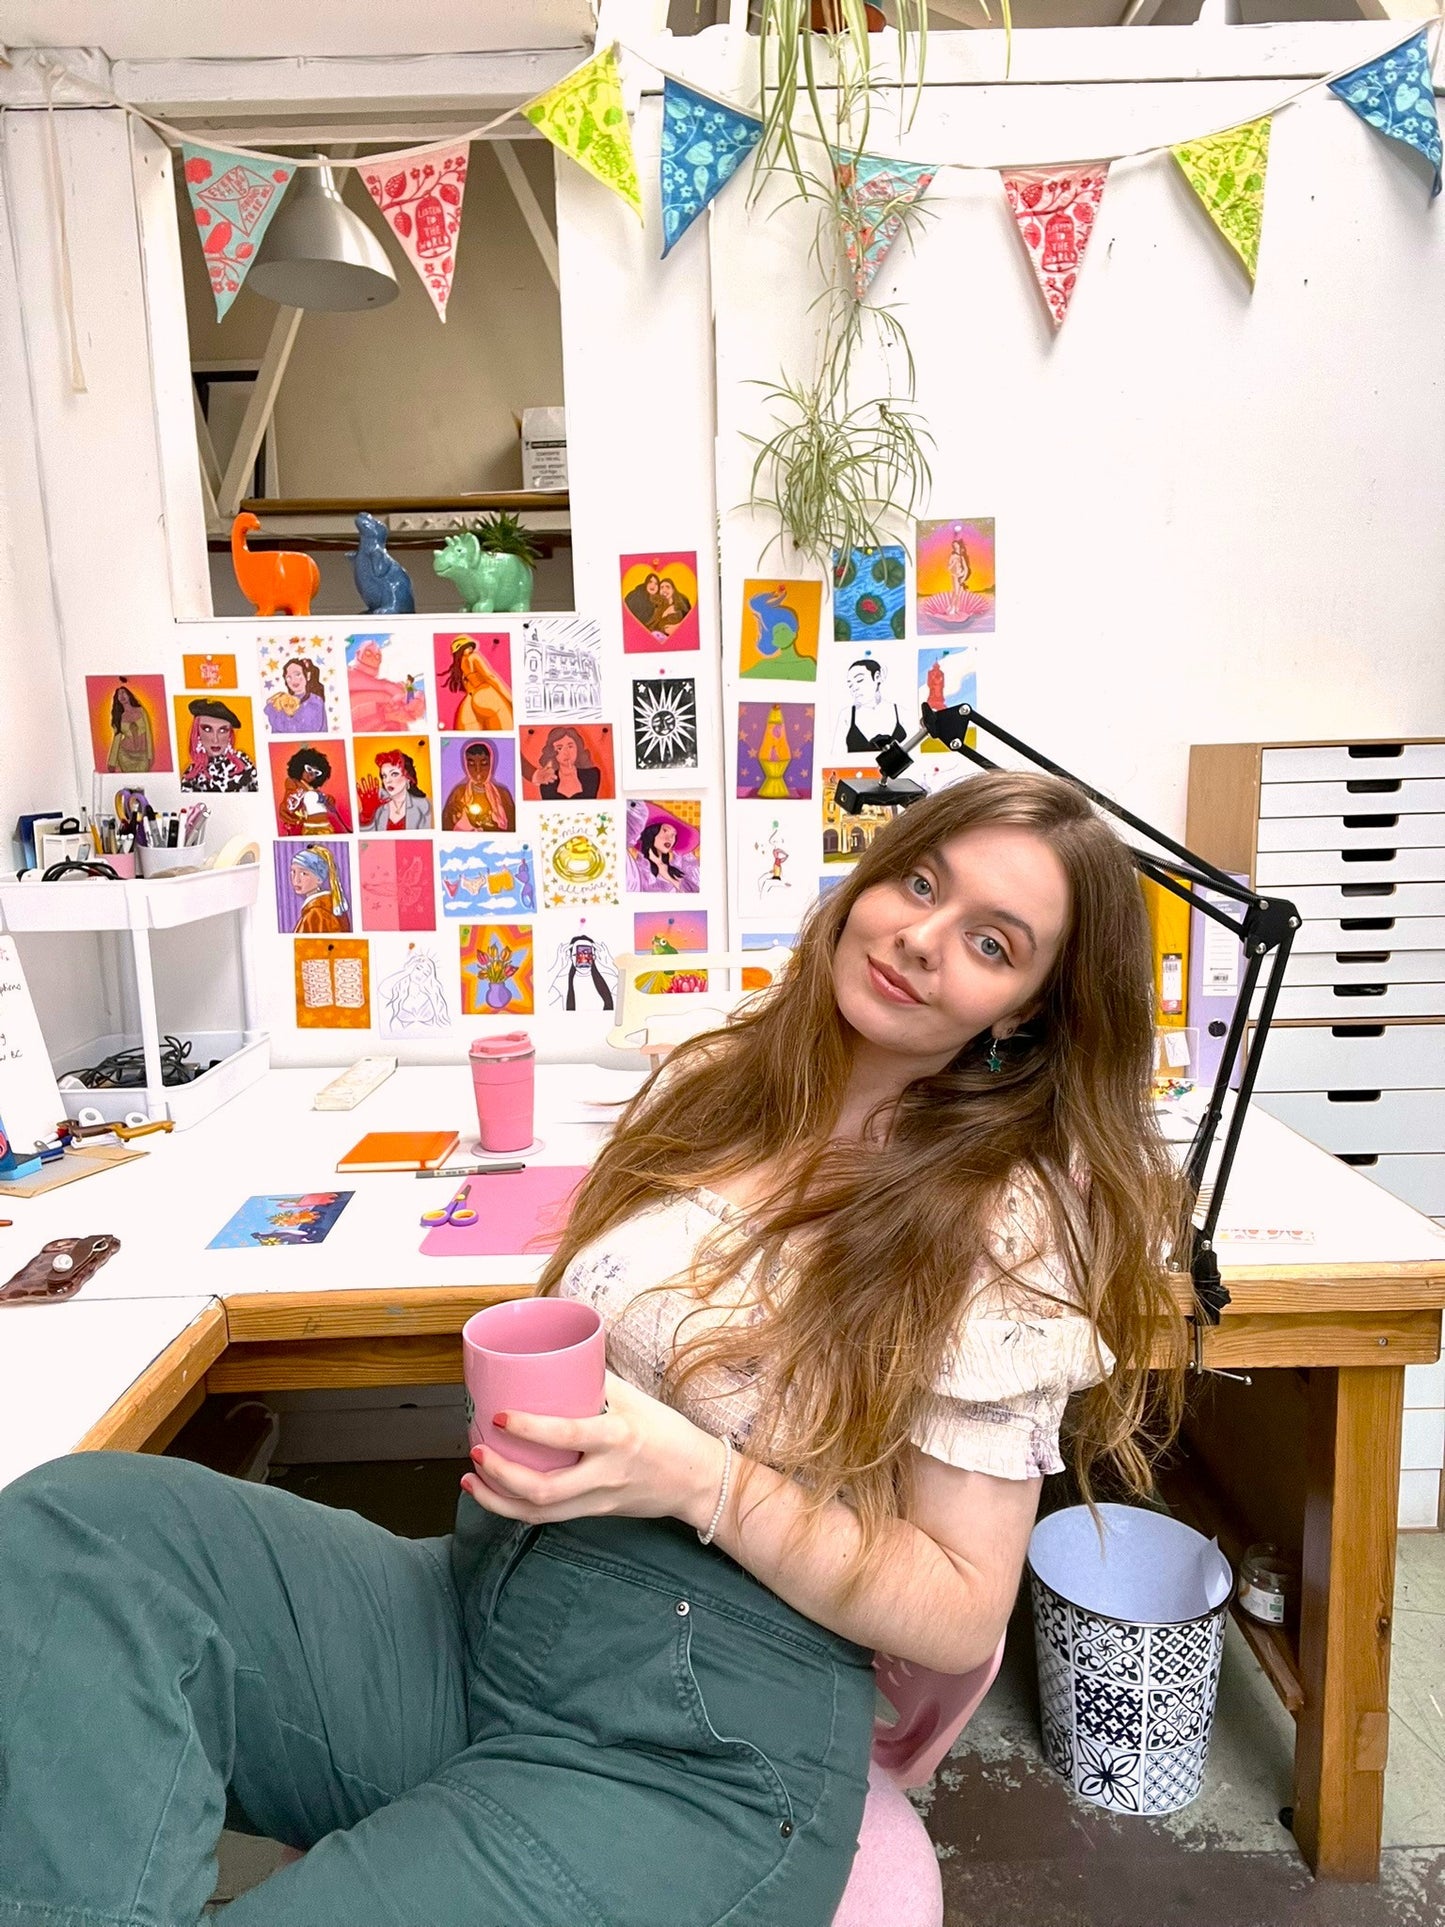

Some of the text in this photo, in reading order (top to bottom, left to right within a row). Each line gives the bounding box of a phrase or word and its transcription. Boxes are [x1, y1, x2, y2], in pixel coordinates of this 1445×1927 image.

[207, 167, 242, 198] EVERY
[417, 206, 442, 218] LISTEN
[426, 215, 437, 225] TO
[424, 225, 441, 238] THE
[1056, 232, 1066, 240] TO
[418, 235, 450, 249] WORLD
[1051, 242, 1069, 251] THE
[1045, 252, 1076, 263] WORLD
[562, 826, 593, 838] mine
[558, 881, 607, 894] all mine
